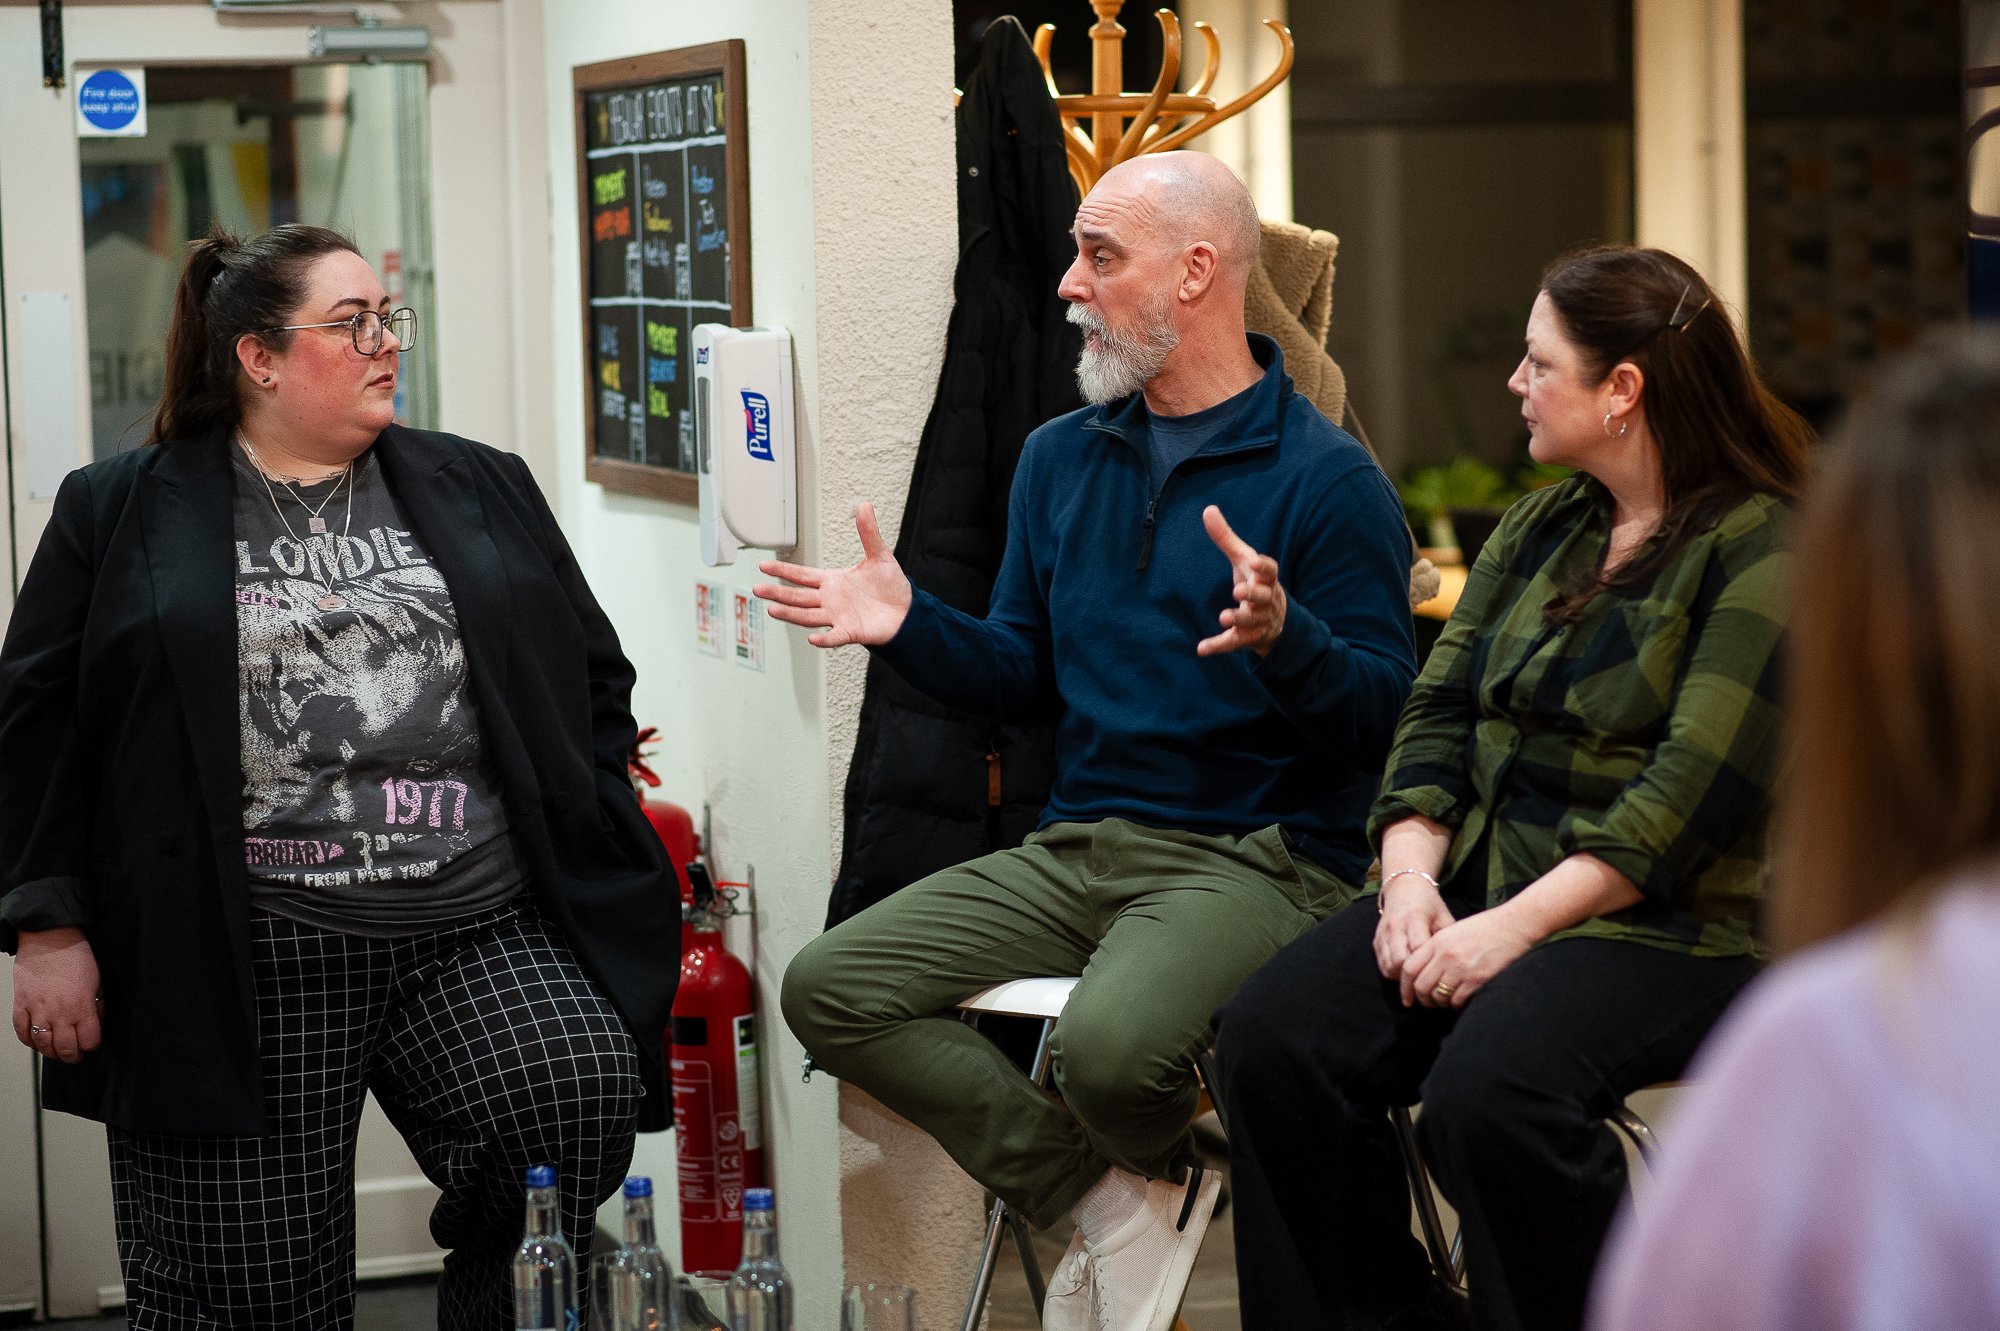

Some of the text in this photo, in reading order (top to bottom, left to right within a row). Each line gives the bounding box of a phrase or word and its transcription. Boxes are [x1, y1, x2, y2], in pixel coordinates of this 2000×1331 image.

[748, 397, 768, 453] Purell
[235, 526, 428, 581] LONDIE
[381, 777, 468, 830] 1977
[304, 871, 350, 887] FROM
